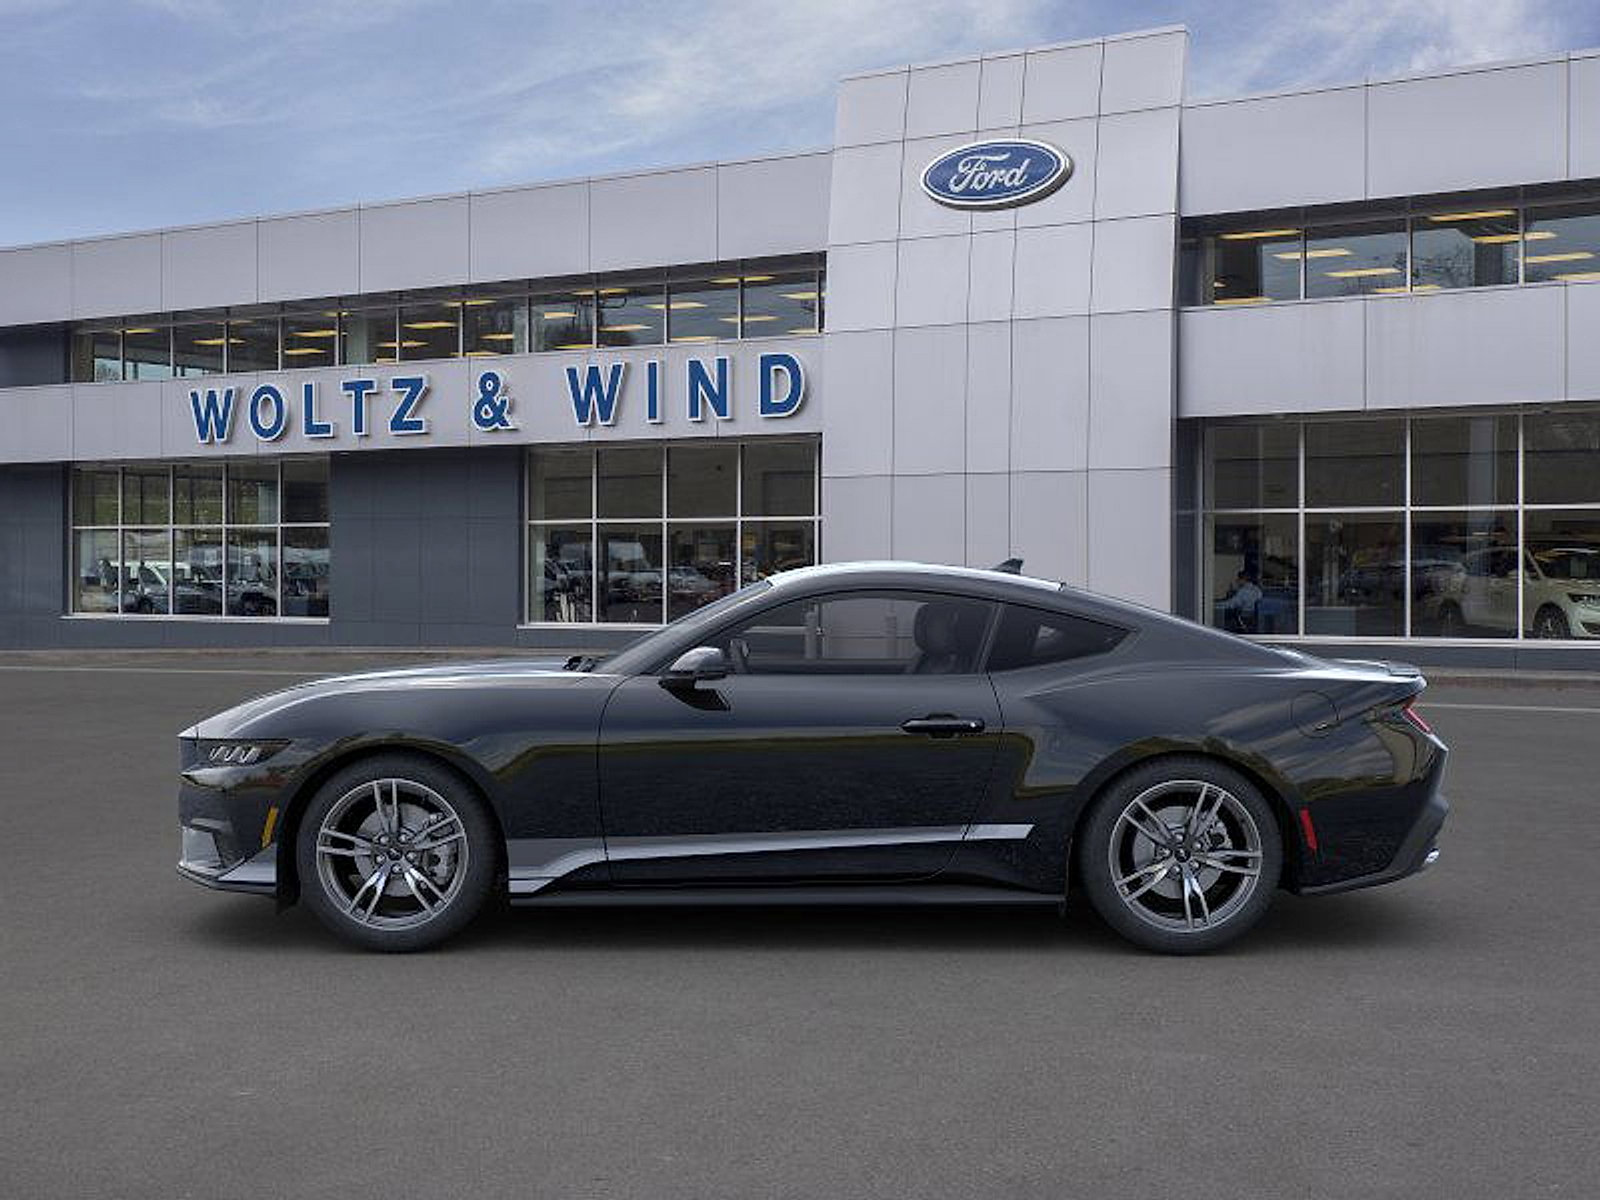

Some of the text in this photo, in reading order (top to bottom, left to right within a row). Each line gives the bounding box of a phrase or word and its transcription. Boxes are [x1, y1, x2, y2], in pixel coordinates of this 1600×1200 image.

[949, 152, 1032, 193] Ford
[190, 352, 806, 443] WOLTZ & WIND
